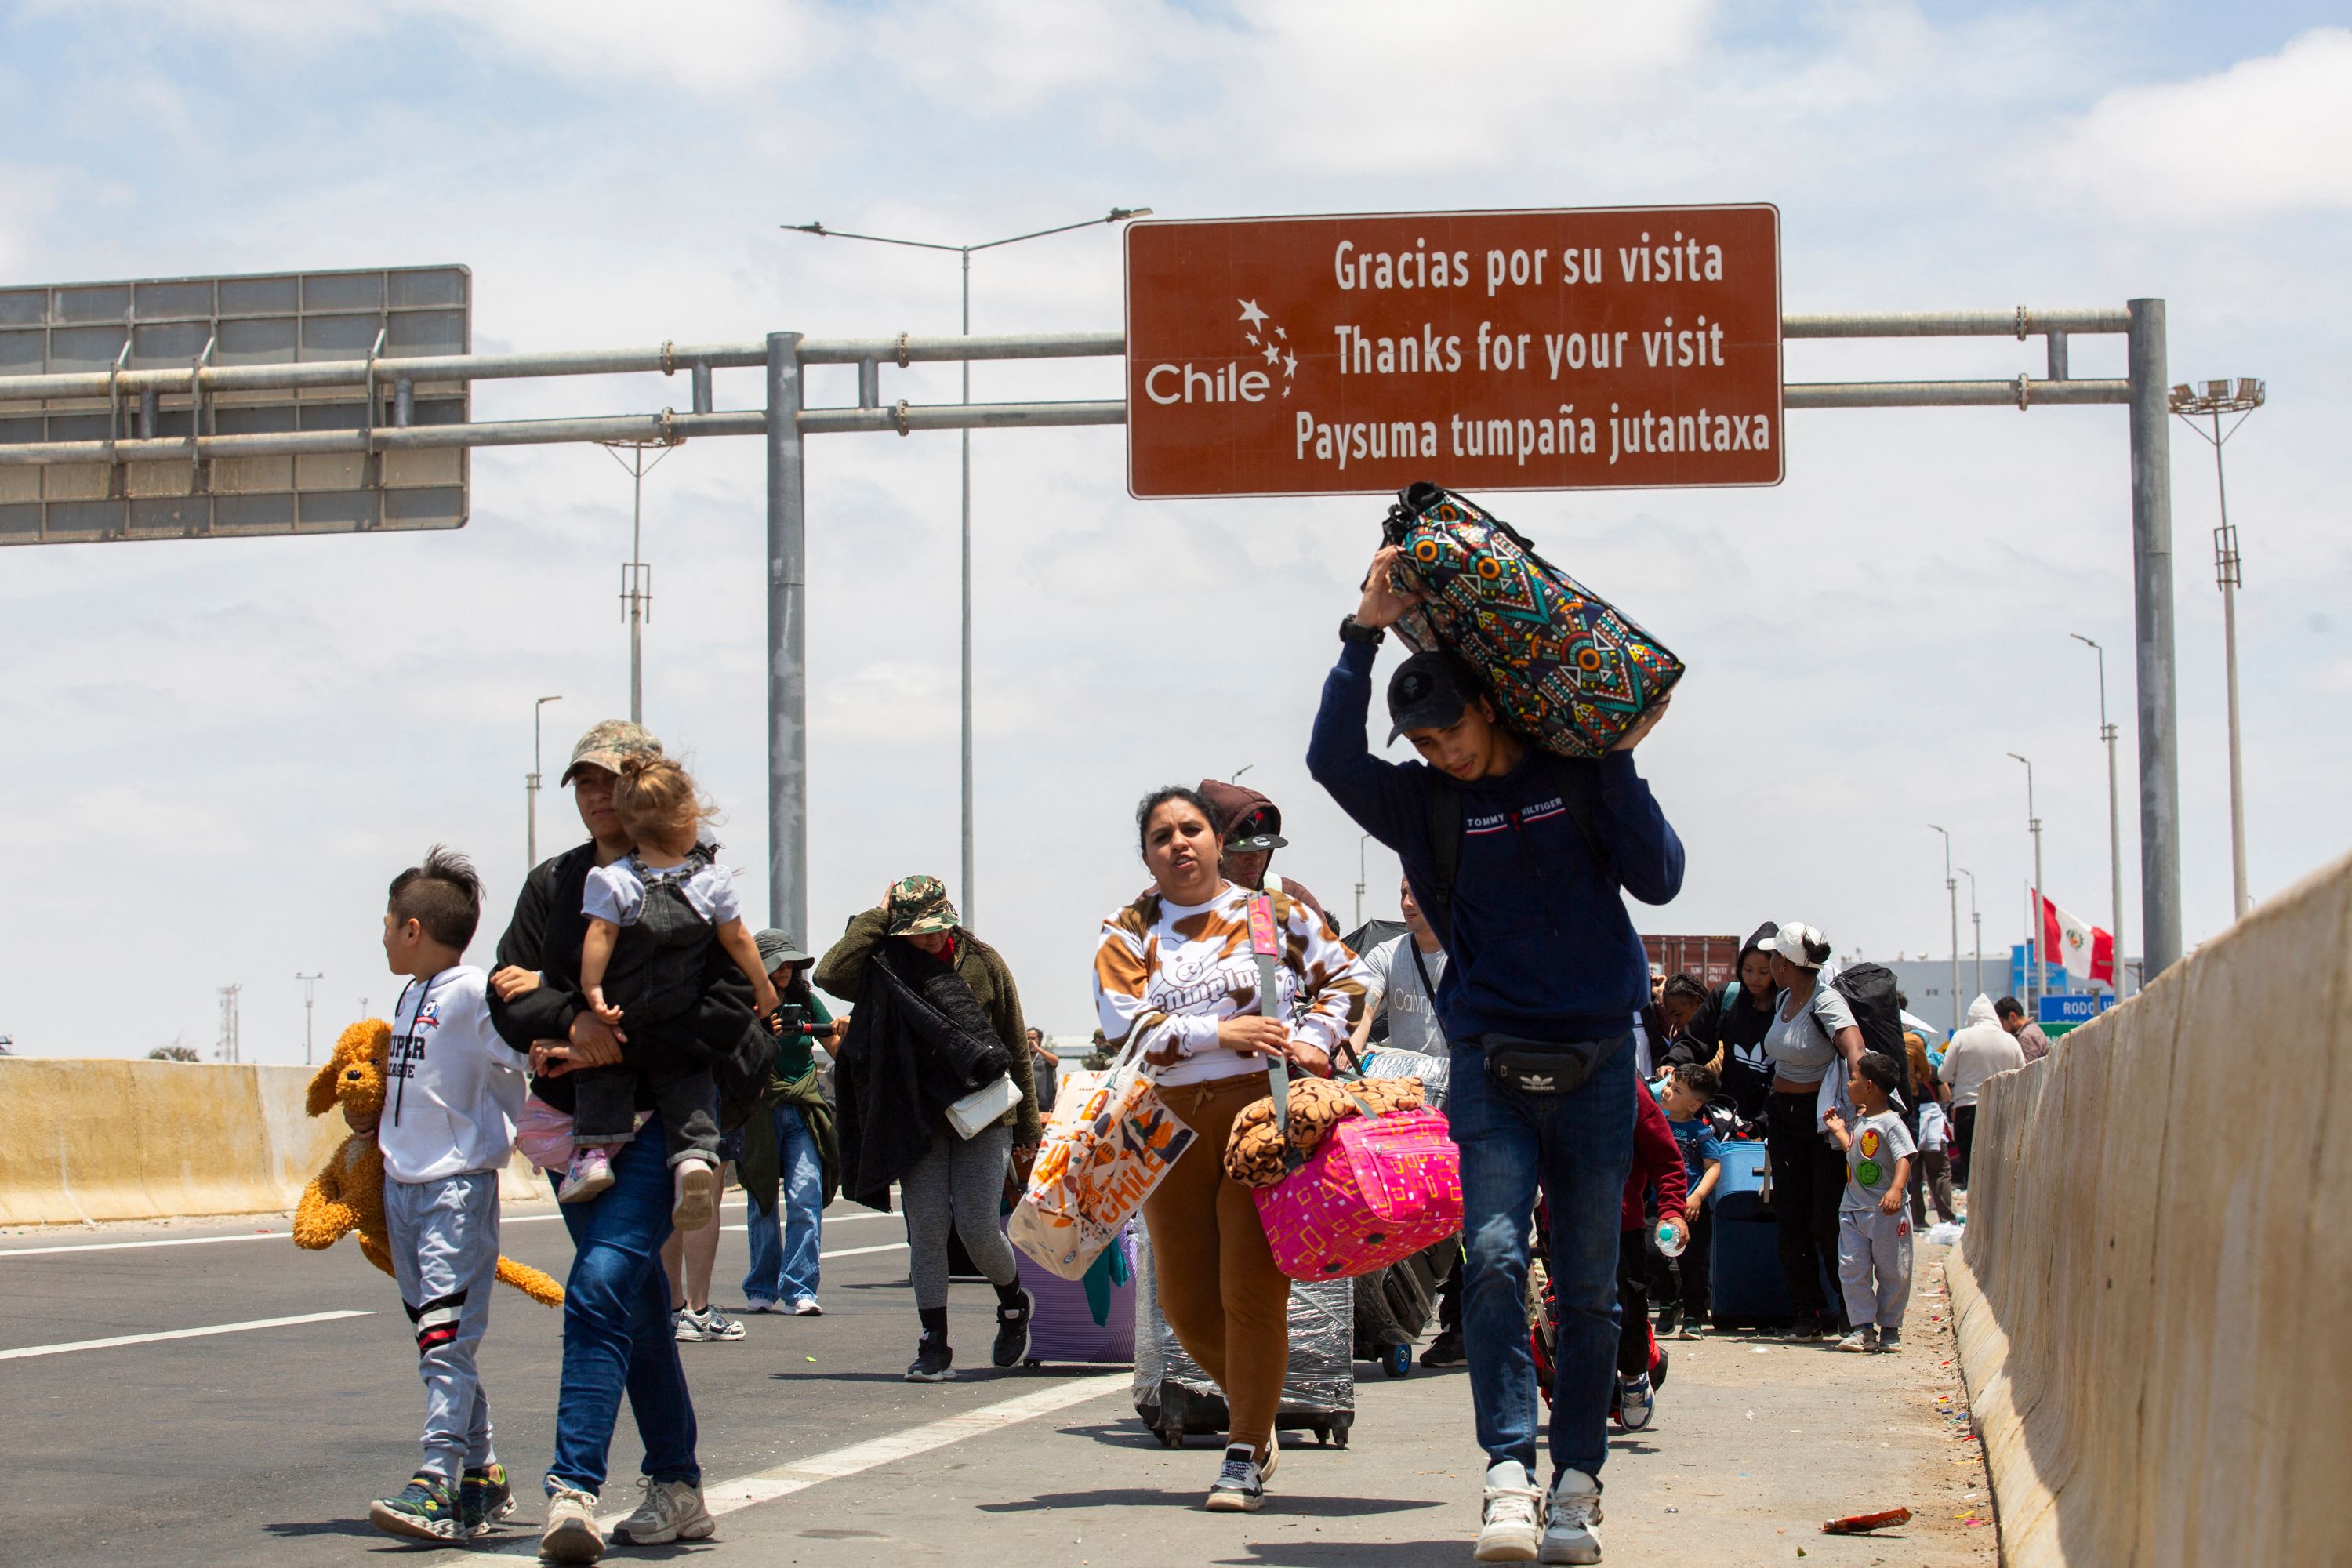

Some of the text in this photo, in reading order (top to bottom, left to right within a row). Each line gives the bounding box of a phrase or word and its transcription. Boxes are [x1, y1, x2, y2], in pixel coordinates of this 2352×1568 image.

[1335, 231, 1722, 296] Gracias por su visita
[1335, 316, 1723, 379] Thanks for your visit
[1145, 362, 1269, 404] Chile
[1297, 403, 1769, 469] Paysuma tumpaña jutantaxa
[1467, 797, 1562, 826] TOMMY HILFIGER
[1394, 988, 1427, 1014] Calvn
[390, 1035, 426, 1060] UPER
[387, 1062, 415, 1079] EAGUE
